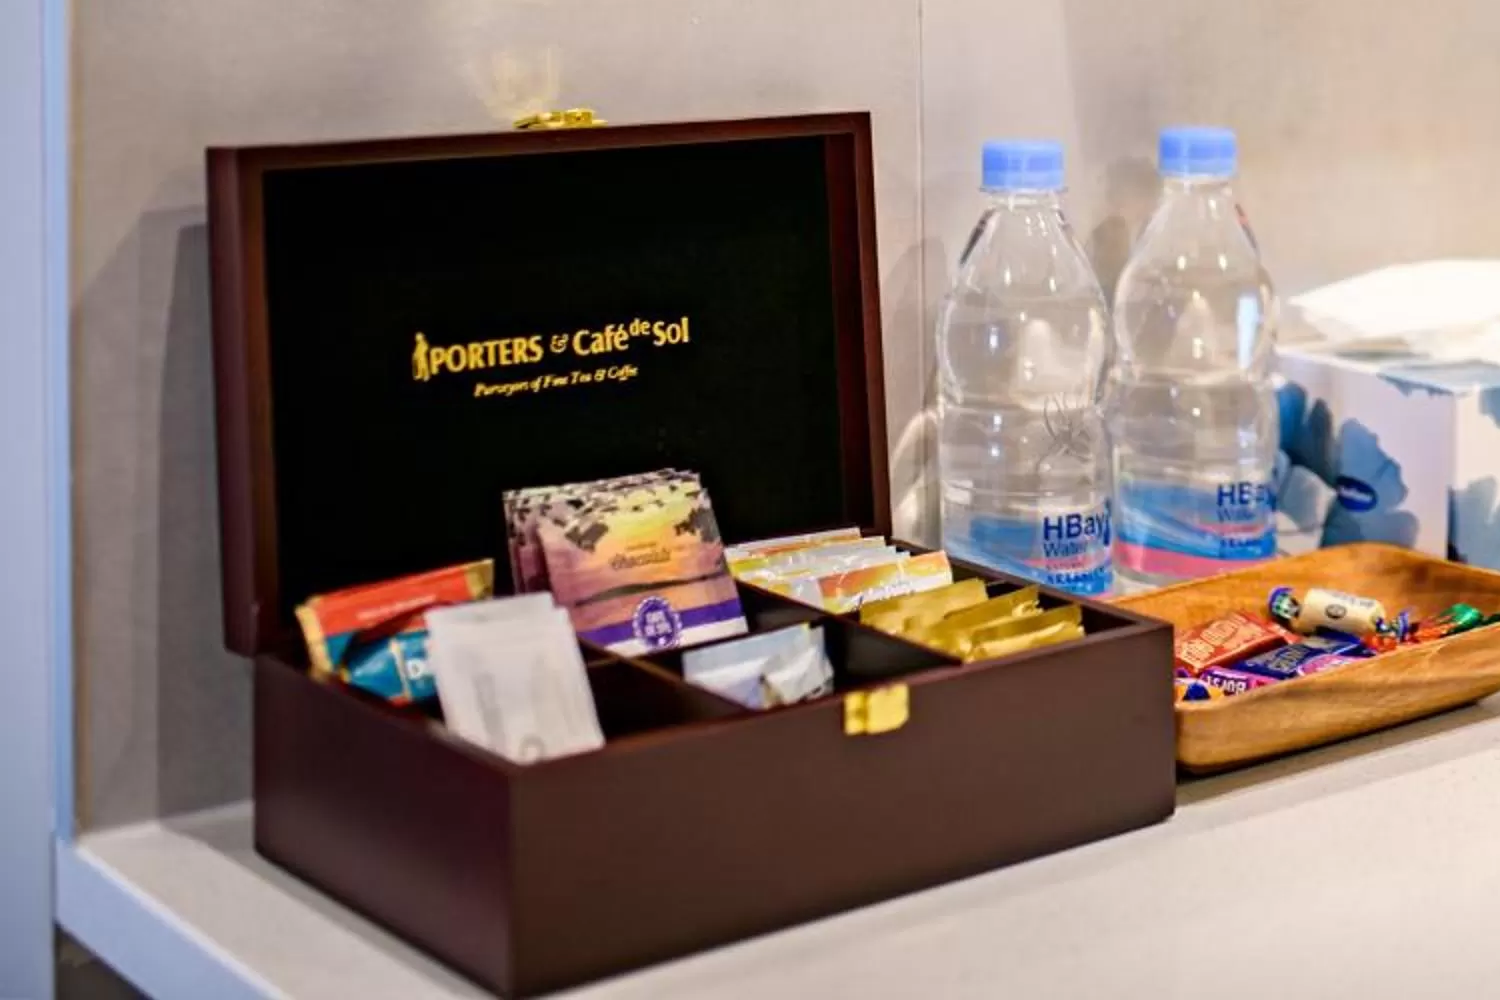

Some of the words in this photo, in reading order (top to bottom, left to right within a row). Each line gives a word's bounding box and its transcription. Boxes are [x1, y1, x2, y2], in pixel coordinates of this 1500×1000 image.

[429, 335, 544, 375] PORTERS
[550, 334, 569, 353] &
[573, 323, 629, 355] Café
[629, 318, 651, 337] de
[653, 317, 690, 346] Sol
[530, 375, 543, 393] of
[570, 371, 592, 385] Tea
